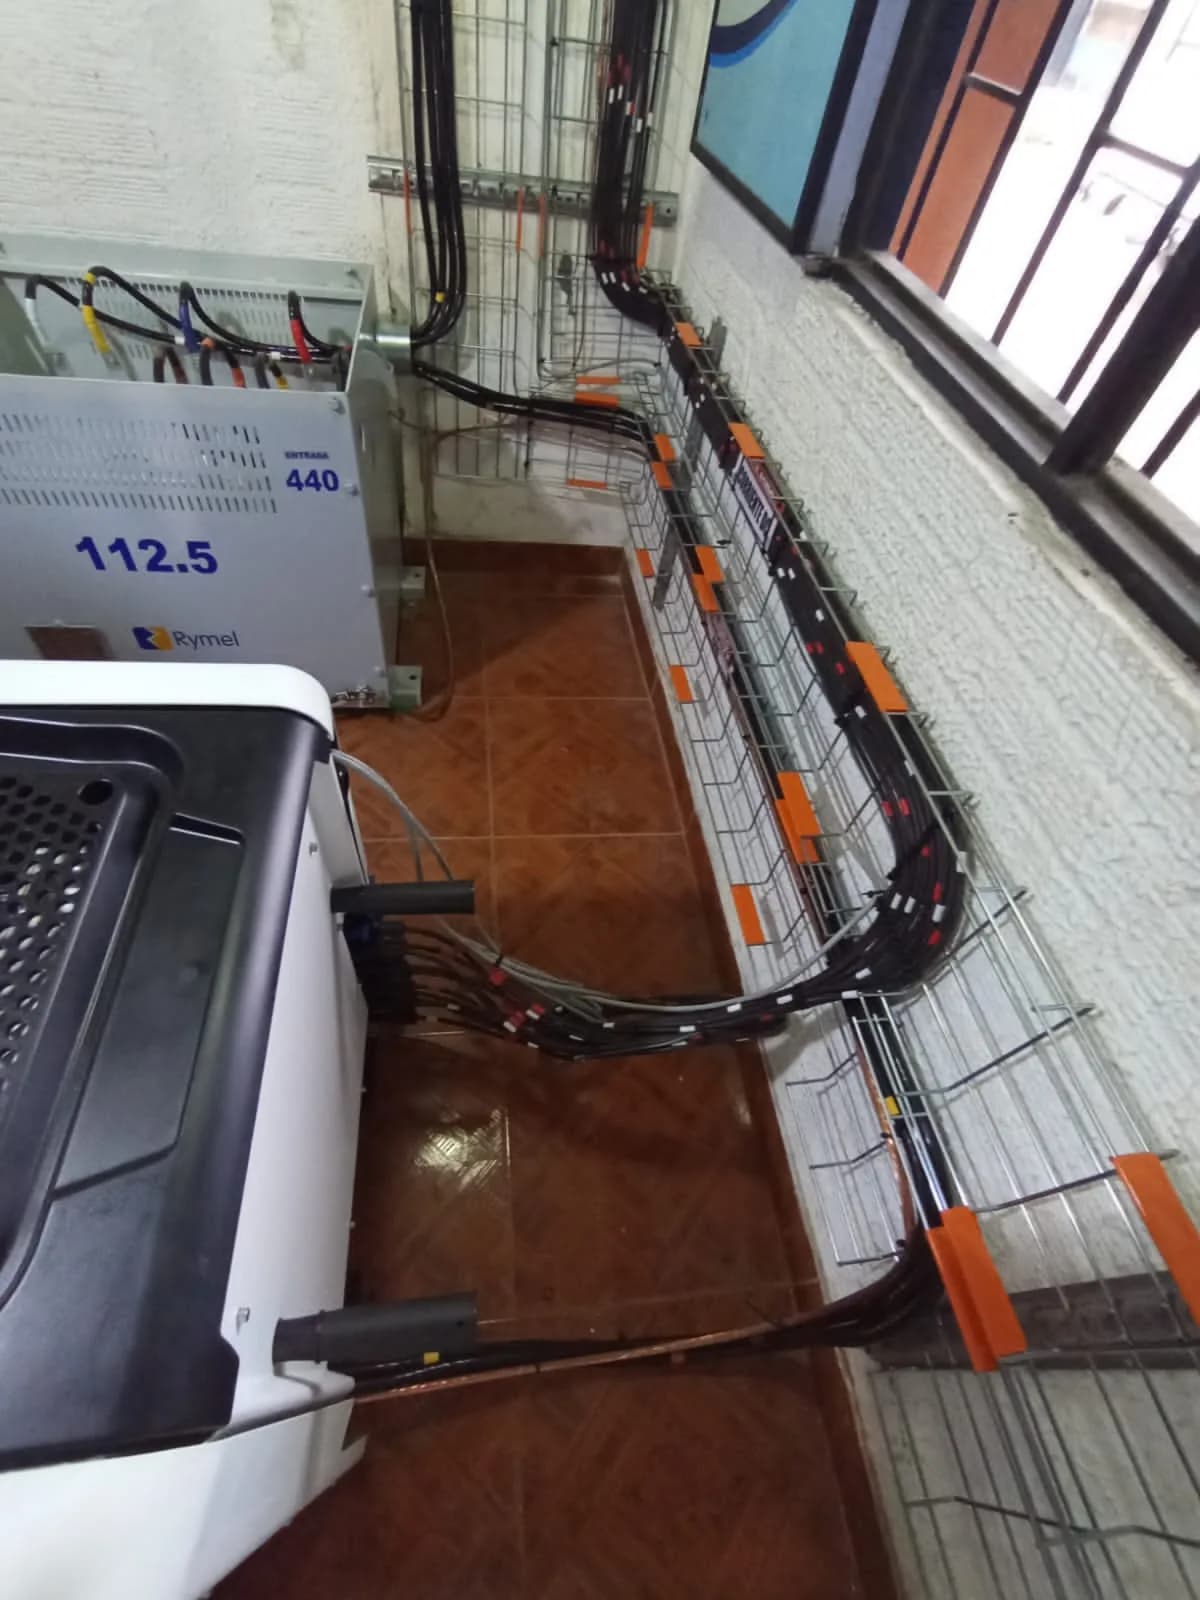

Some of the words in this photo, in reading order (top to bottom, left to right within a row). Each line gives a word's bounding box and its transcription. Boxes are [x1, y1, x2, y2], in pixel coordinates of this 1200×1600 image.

[286, 469, 339, 492] 440
[75, 536, 218, 574] 112.5
[172, 629, 240, 651] Rymel
